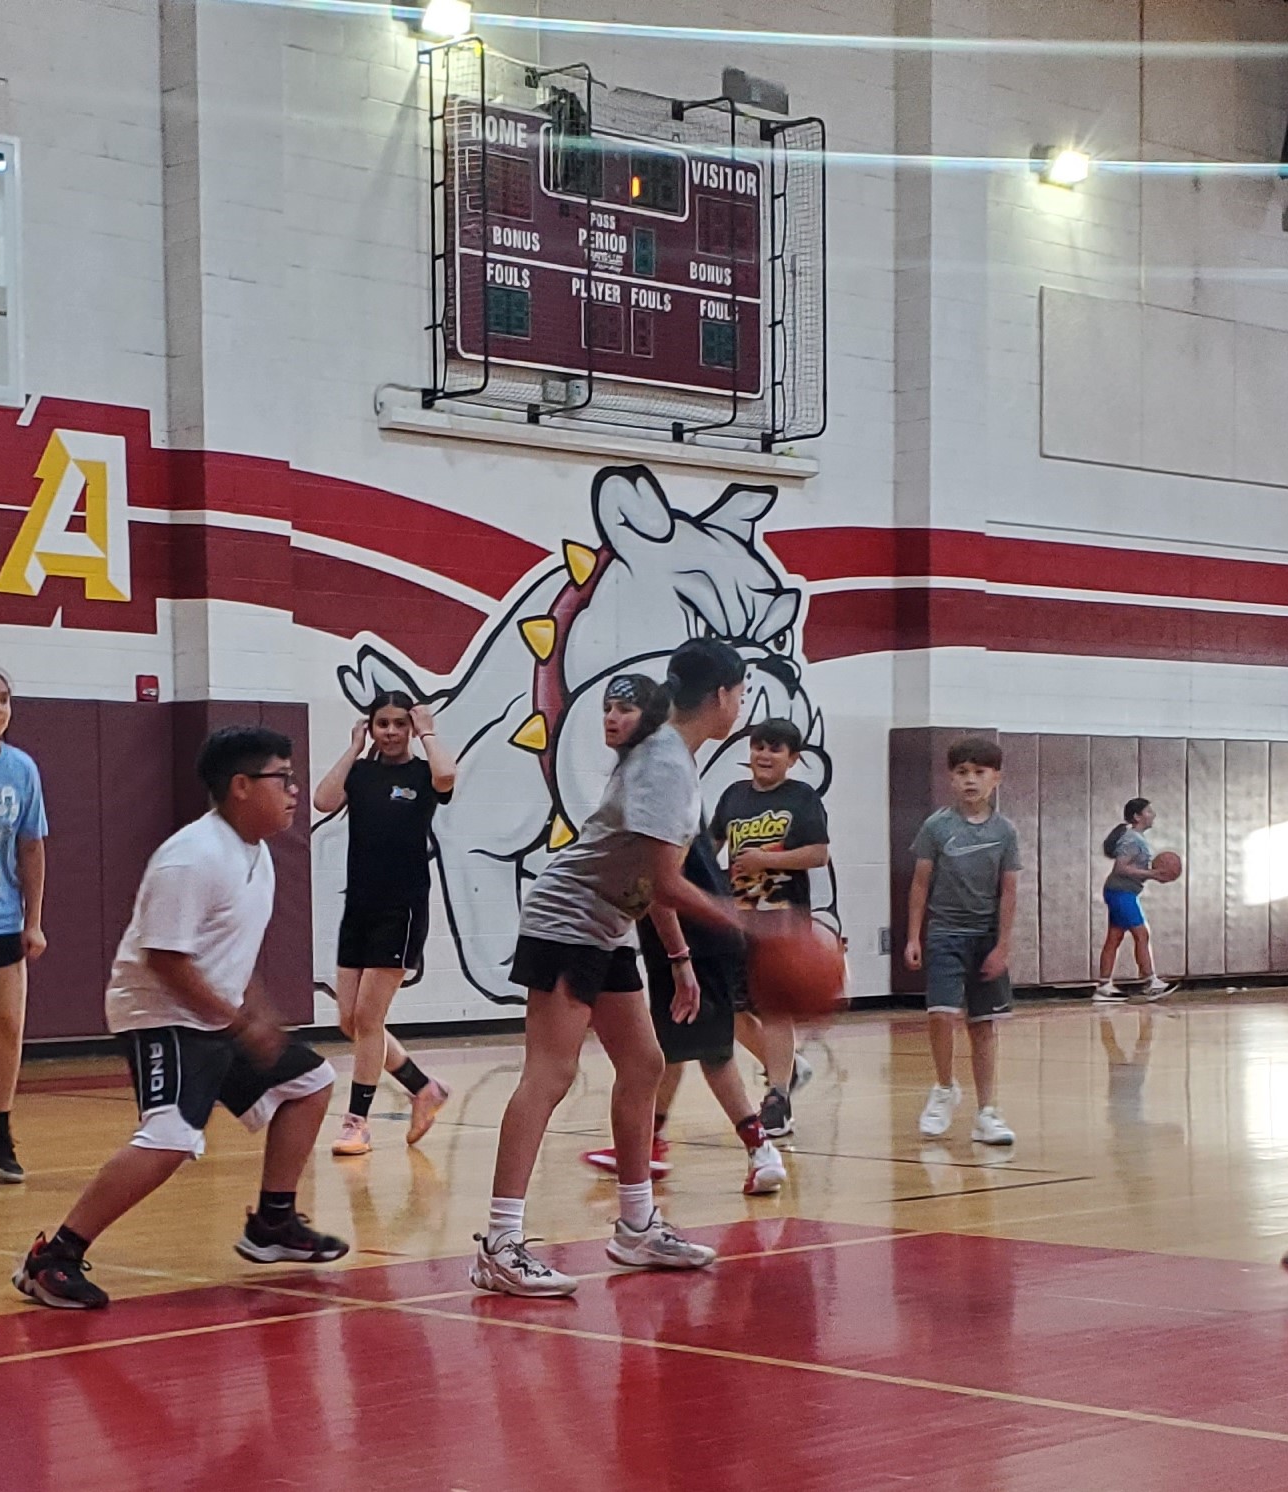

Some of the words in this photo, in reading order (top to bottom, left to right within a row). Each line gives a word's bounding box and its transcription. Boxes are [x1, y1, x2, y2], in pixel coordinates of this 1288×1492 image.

[471, 112, 528, 149] HOME
[691, 159, 757, 197] VISITOR
[590, 212, 616, 230] POSS
[492, 225, 541, 252] BONUS
[486, 262, 531, 289] FOULS
[689, 261, 732, 286] BONUS
[572, 277, 621, 304] PLAYER
[631, 287, 672, 312] FOULS
